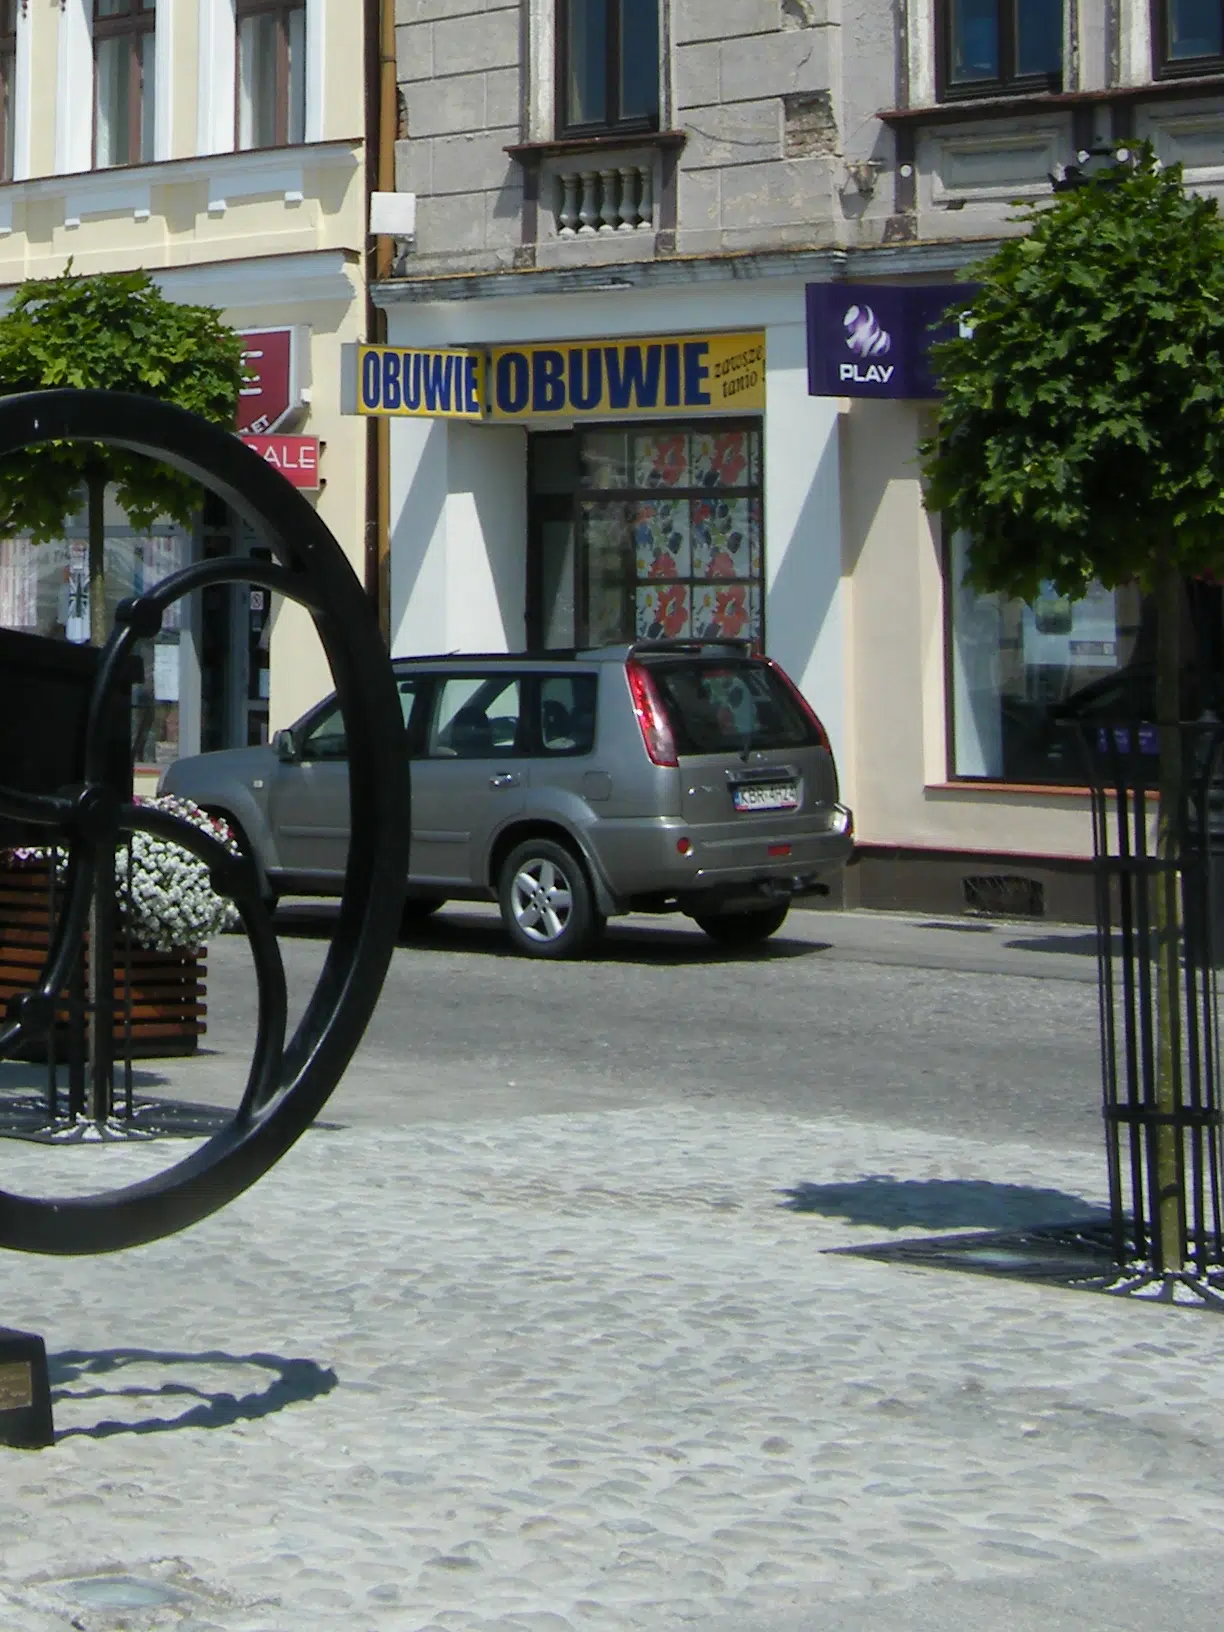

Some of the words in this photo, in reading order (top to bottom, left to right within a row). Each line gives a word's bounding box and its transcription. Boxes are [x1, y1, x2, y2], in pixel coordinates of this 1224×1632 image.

[714, 345, 763, 378] zawsze
[839, 364, 894, 383] PLAY
[362, 351, 480, 413] OBUWIE
[496, 342, 711, 413] OBUWIE
[722, 370, 758, 398] tanio
[247, 444, 315, 468] ALE
